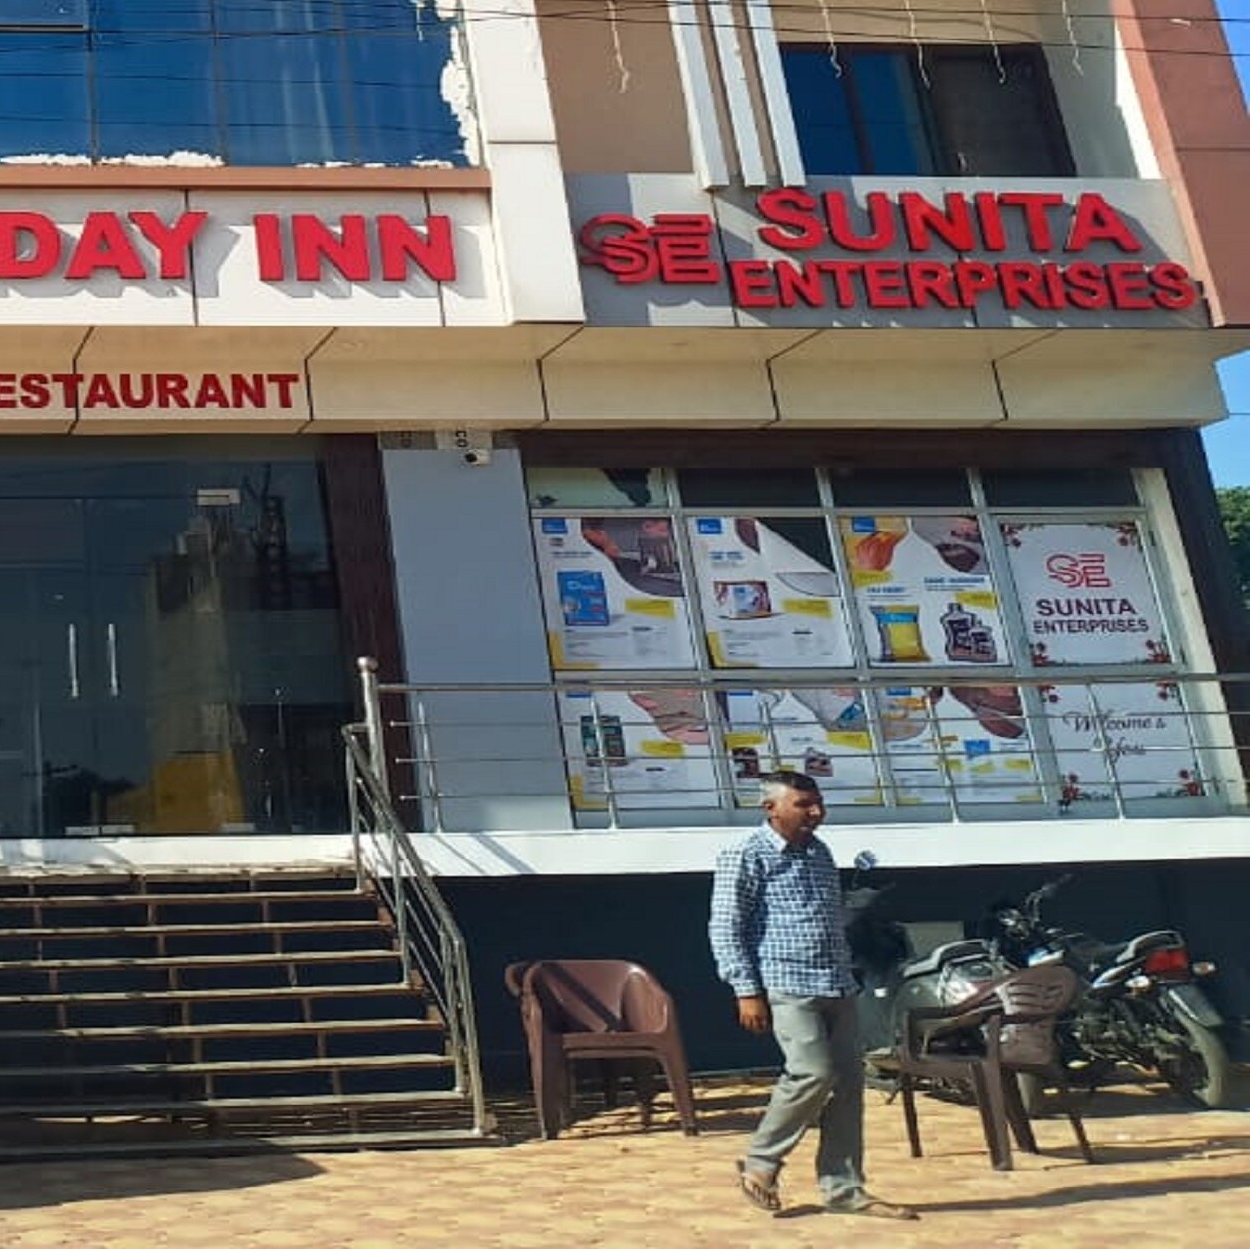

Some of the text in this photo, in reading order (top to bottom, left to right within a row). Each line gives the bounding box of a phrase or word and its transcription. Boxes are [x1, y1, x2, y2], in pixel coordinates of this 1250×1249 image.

[757, 187, 1144, 254] SUNITA
[254, 214, 457, 282] INN
[729, 259, 1201, 312] ENTERPRISES
[1036, 599, 1136, 616] SUNITA
[1033, 620, 1149, 633] ENTERPRISES
[1063, 710, 1151, 731] Wcome
